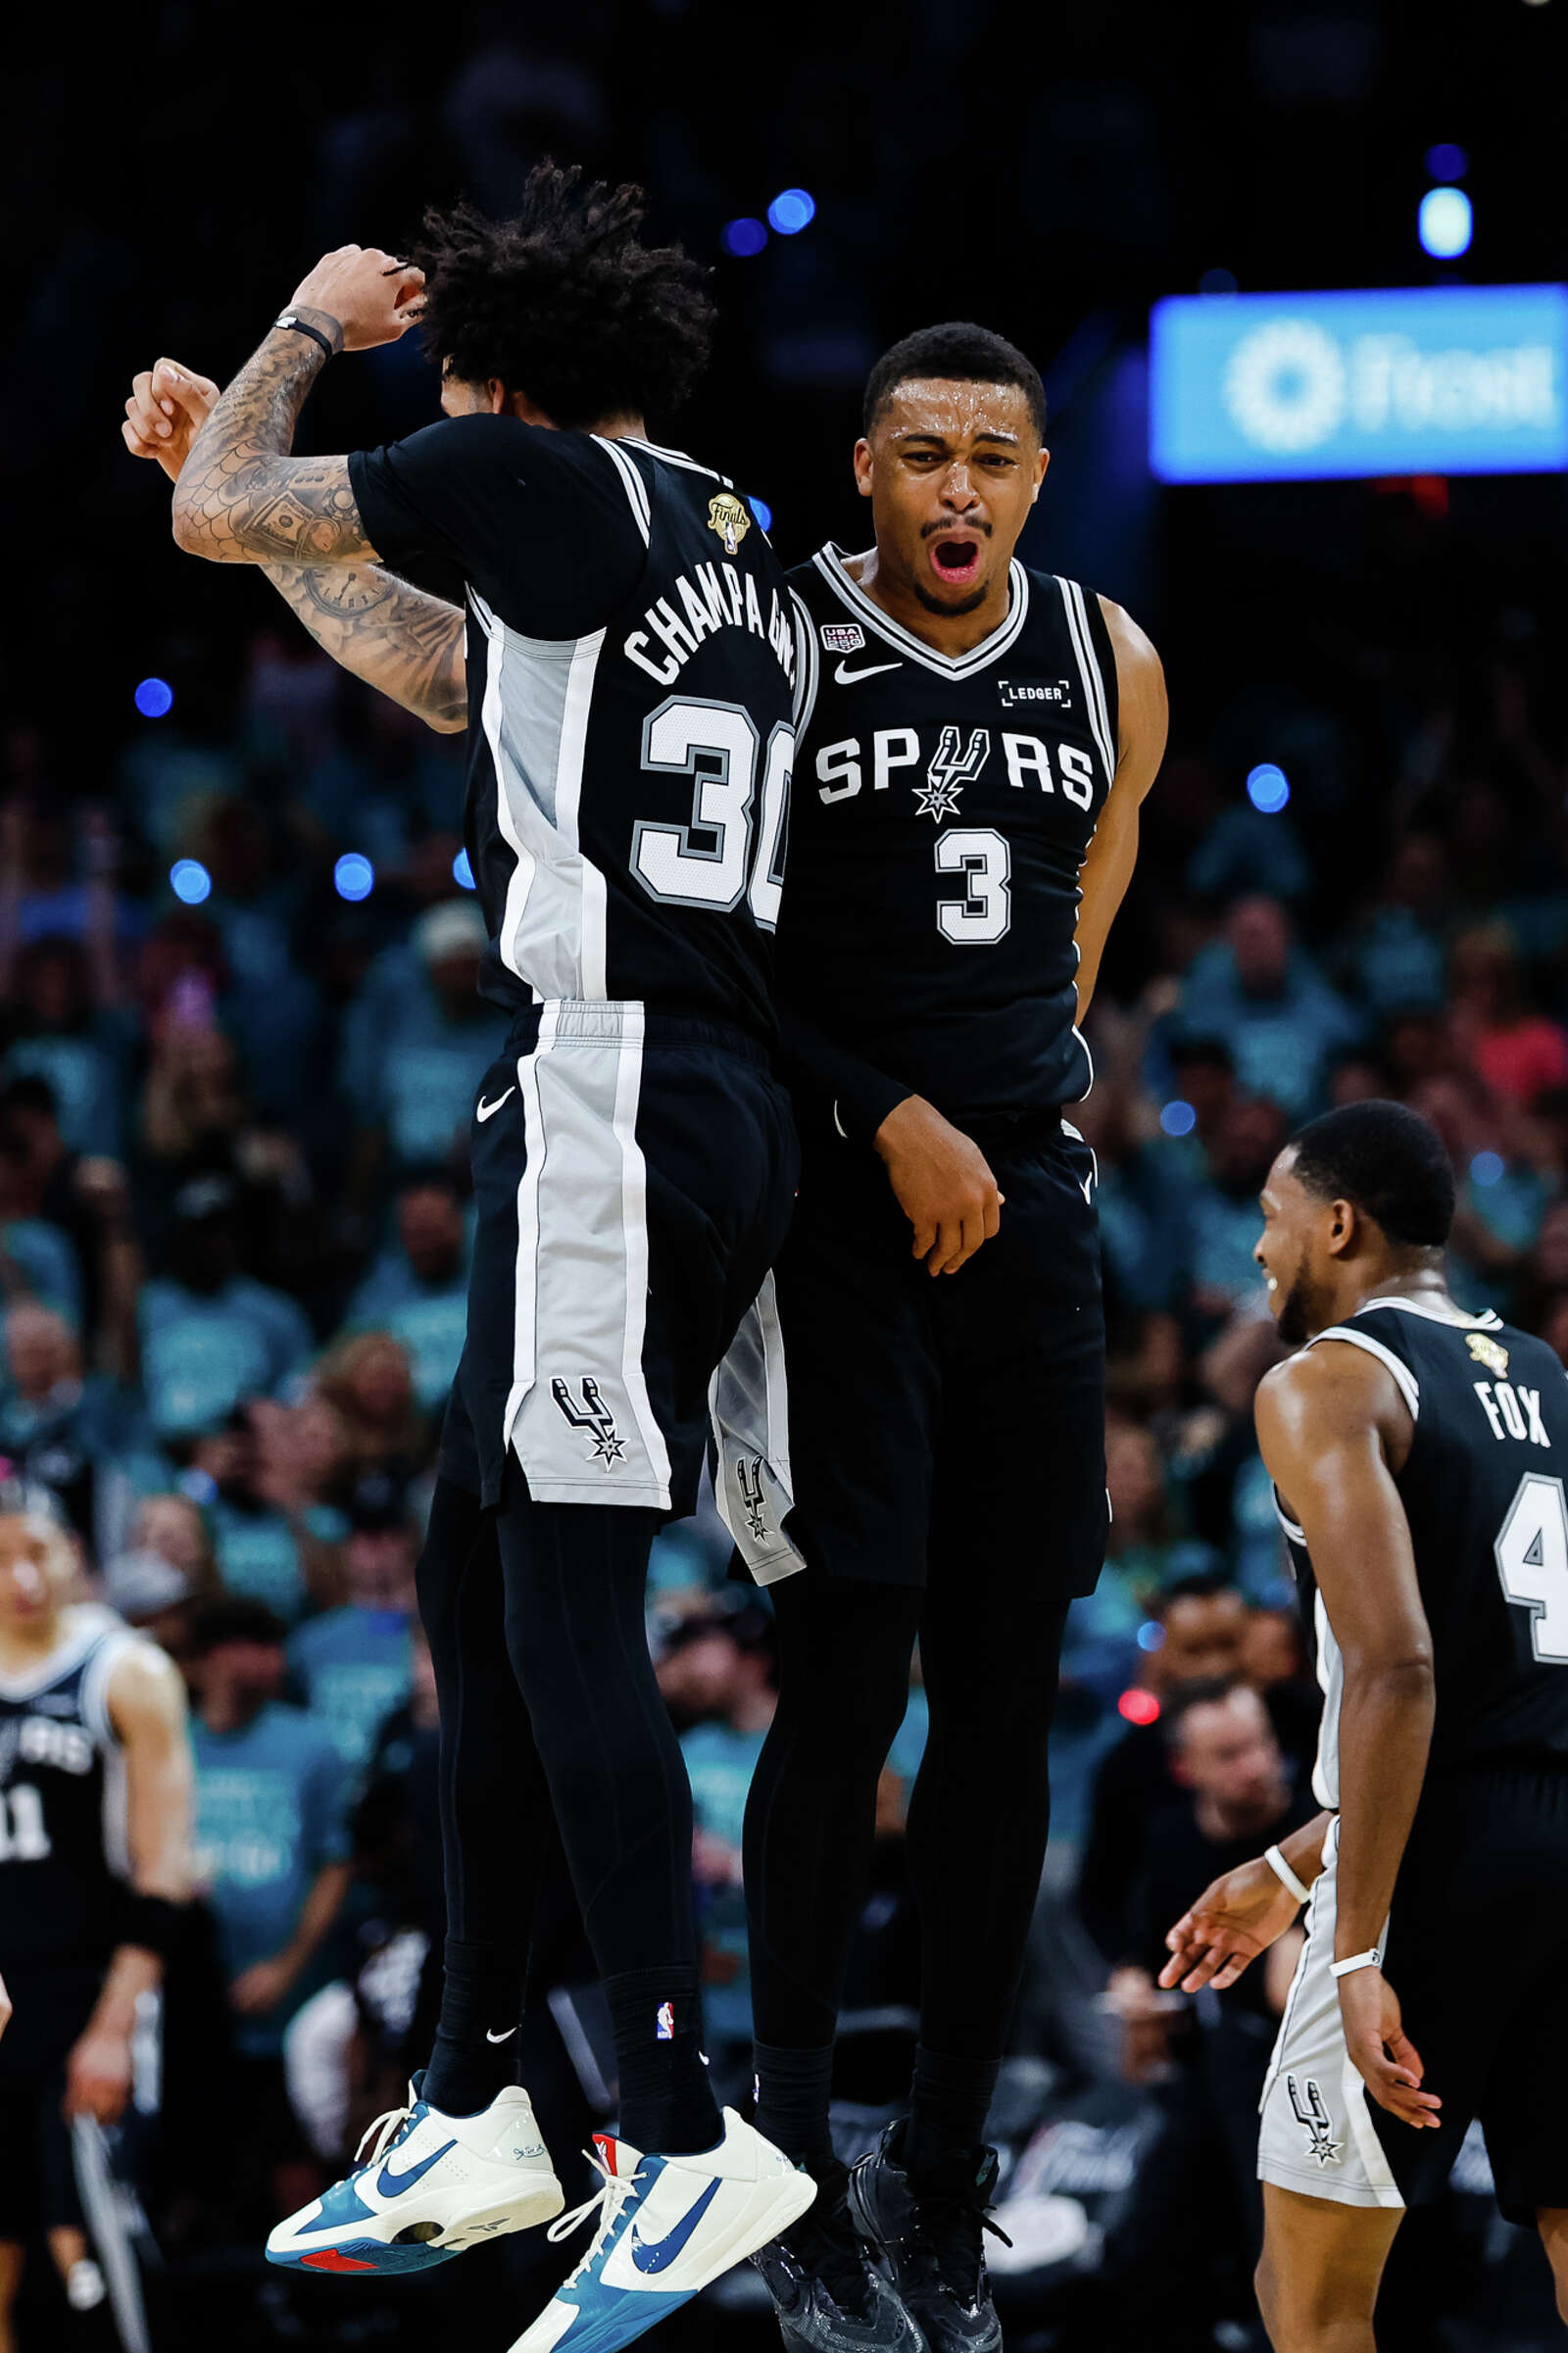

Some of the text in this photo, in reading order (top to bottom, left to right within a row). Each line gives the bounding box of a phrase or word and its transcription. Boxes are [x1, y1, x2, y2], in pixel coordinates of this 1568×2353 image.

[1008, 687, 1062, 700] LEDGER
[815, 725, 1094, 824] SPURS
[934, 828, 1011, 946] 3
[1473, 1381, 1551, 1448] FOX
[1494, 1471, 1568, 1665] 4
